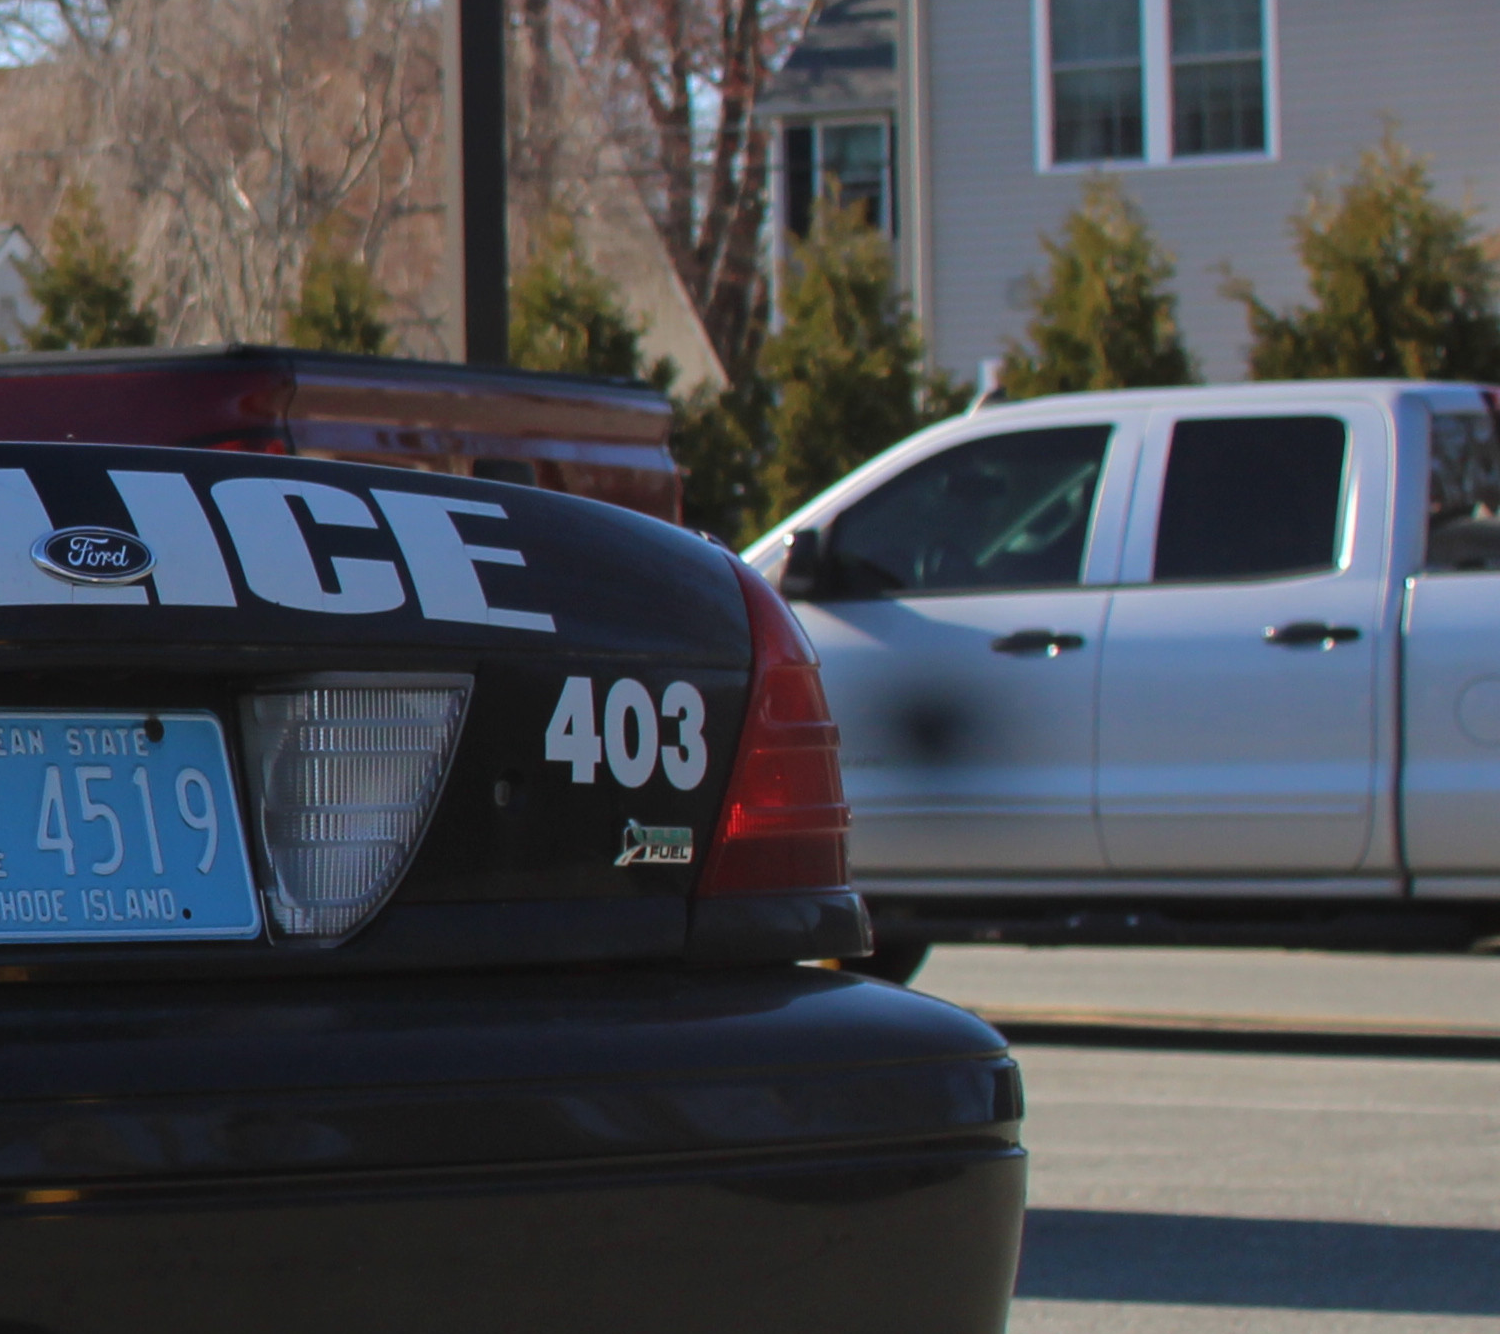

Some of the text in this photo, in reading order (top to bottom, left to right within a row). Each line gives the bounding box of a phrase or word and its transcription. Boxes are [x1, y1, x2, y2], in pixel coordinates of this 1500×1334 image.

[68, 536, 130, 568] Ford
[66, 727, 150, 757] STATE
[545, 676, 707, 791] 403
[37, 766, 218, 875] 4519
[650, 845, 689, 860] FUEL
[81, 888, 177, 922] ISLAND
